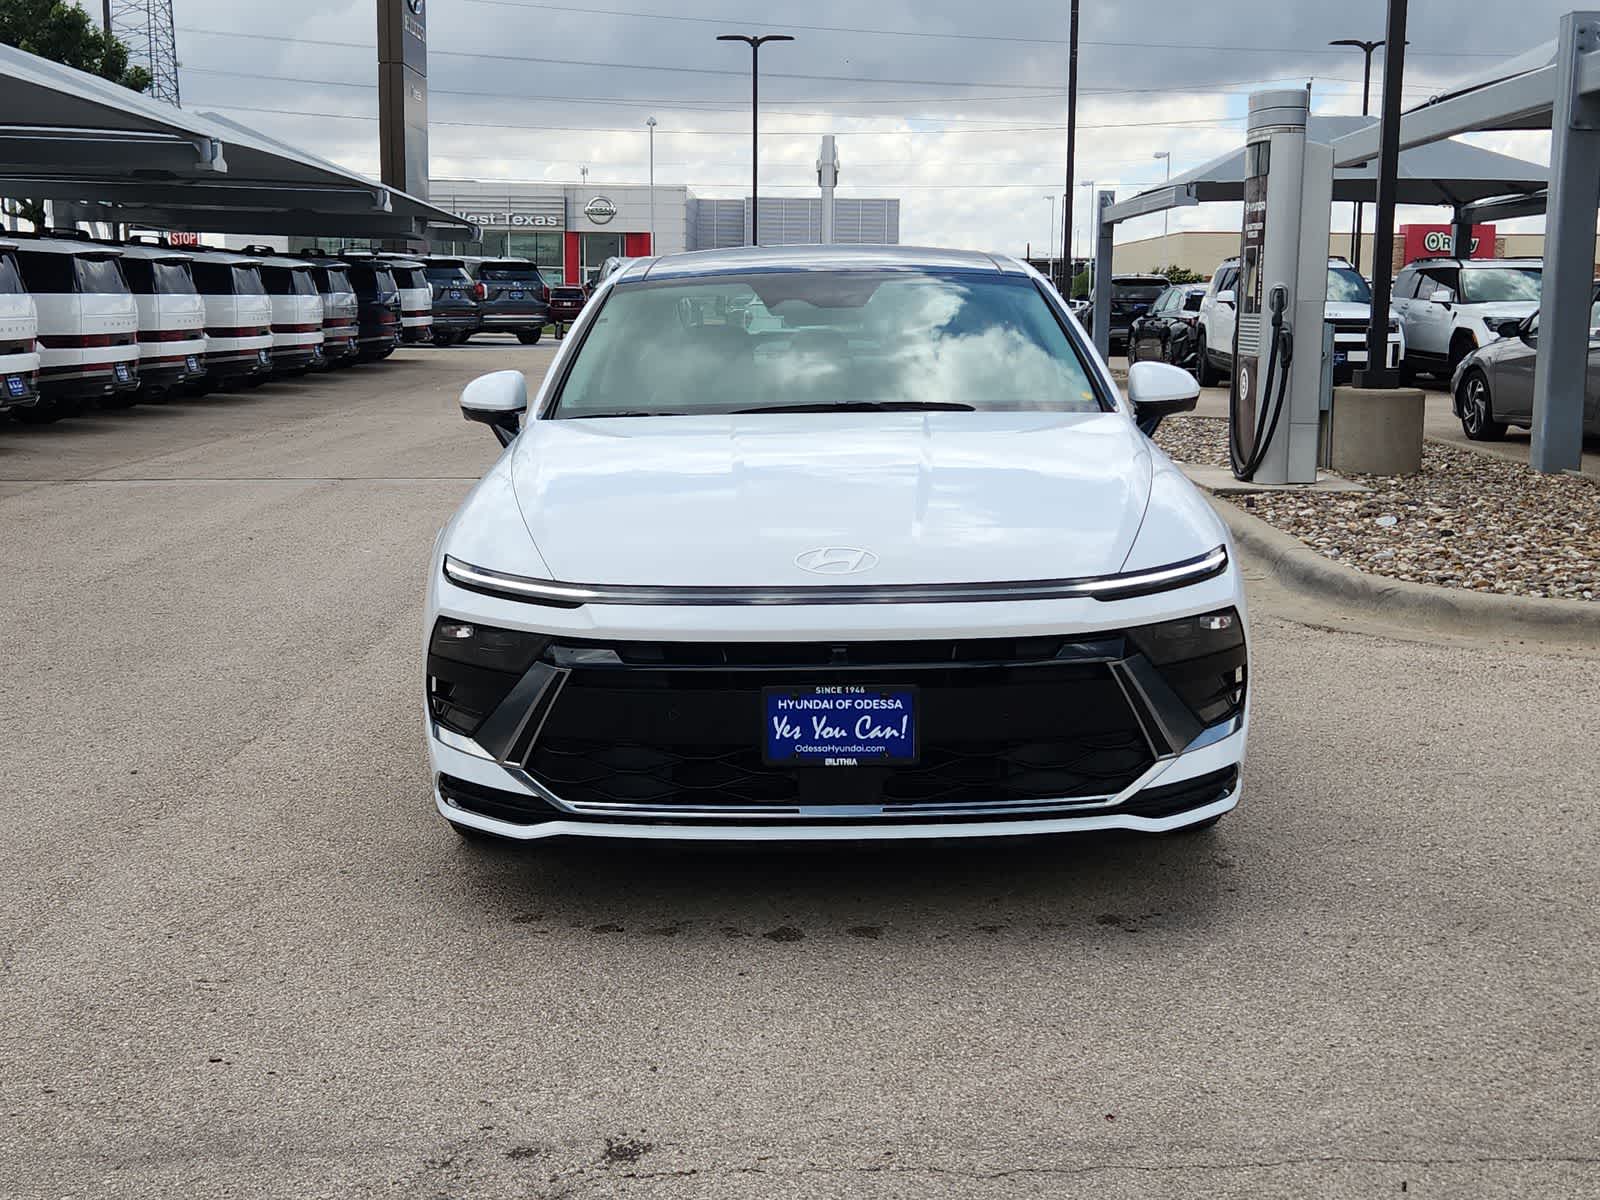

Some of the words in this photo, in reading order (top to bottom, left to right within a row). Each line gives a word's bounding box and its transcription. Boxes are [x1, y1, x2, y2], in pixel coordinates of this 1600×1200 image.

[502, 212, 558, 226] Texas
[172, 232, 196, 245] STOP
[1424, 231, 1480, 253] O'Ry
[815, 686, 842, 694] SINCE
[845, 686, 865, 694] 1946
[778, 700, 833, 710] HYUNDAI
[836, 700, 852, 710] OF
[854, 699, 903, 710] ODESSA
[772, 715, 802, 740] Yes
[811, 715, 848, 740] You
[855, 714, 909, 740] Can!
[795, 744, 886, 753] OdessaHyundai.com
